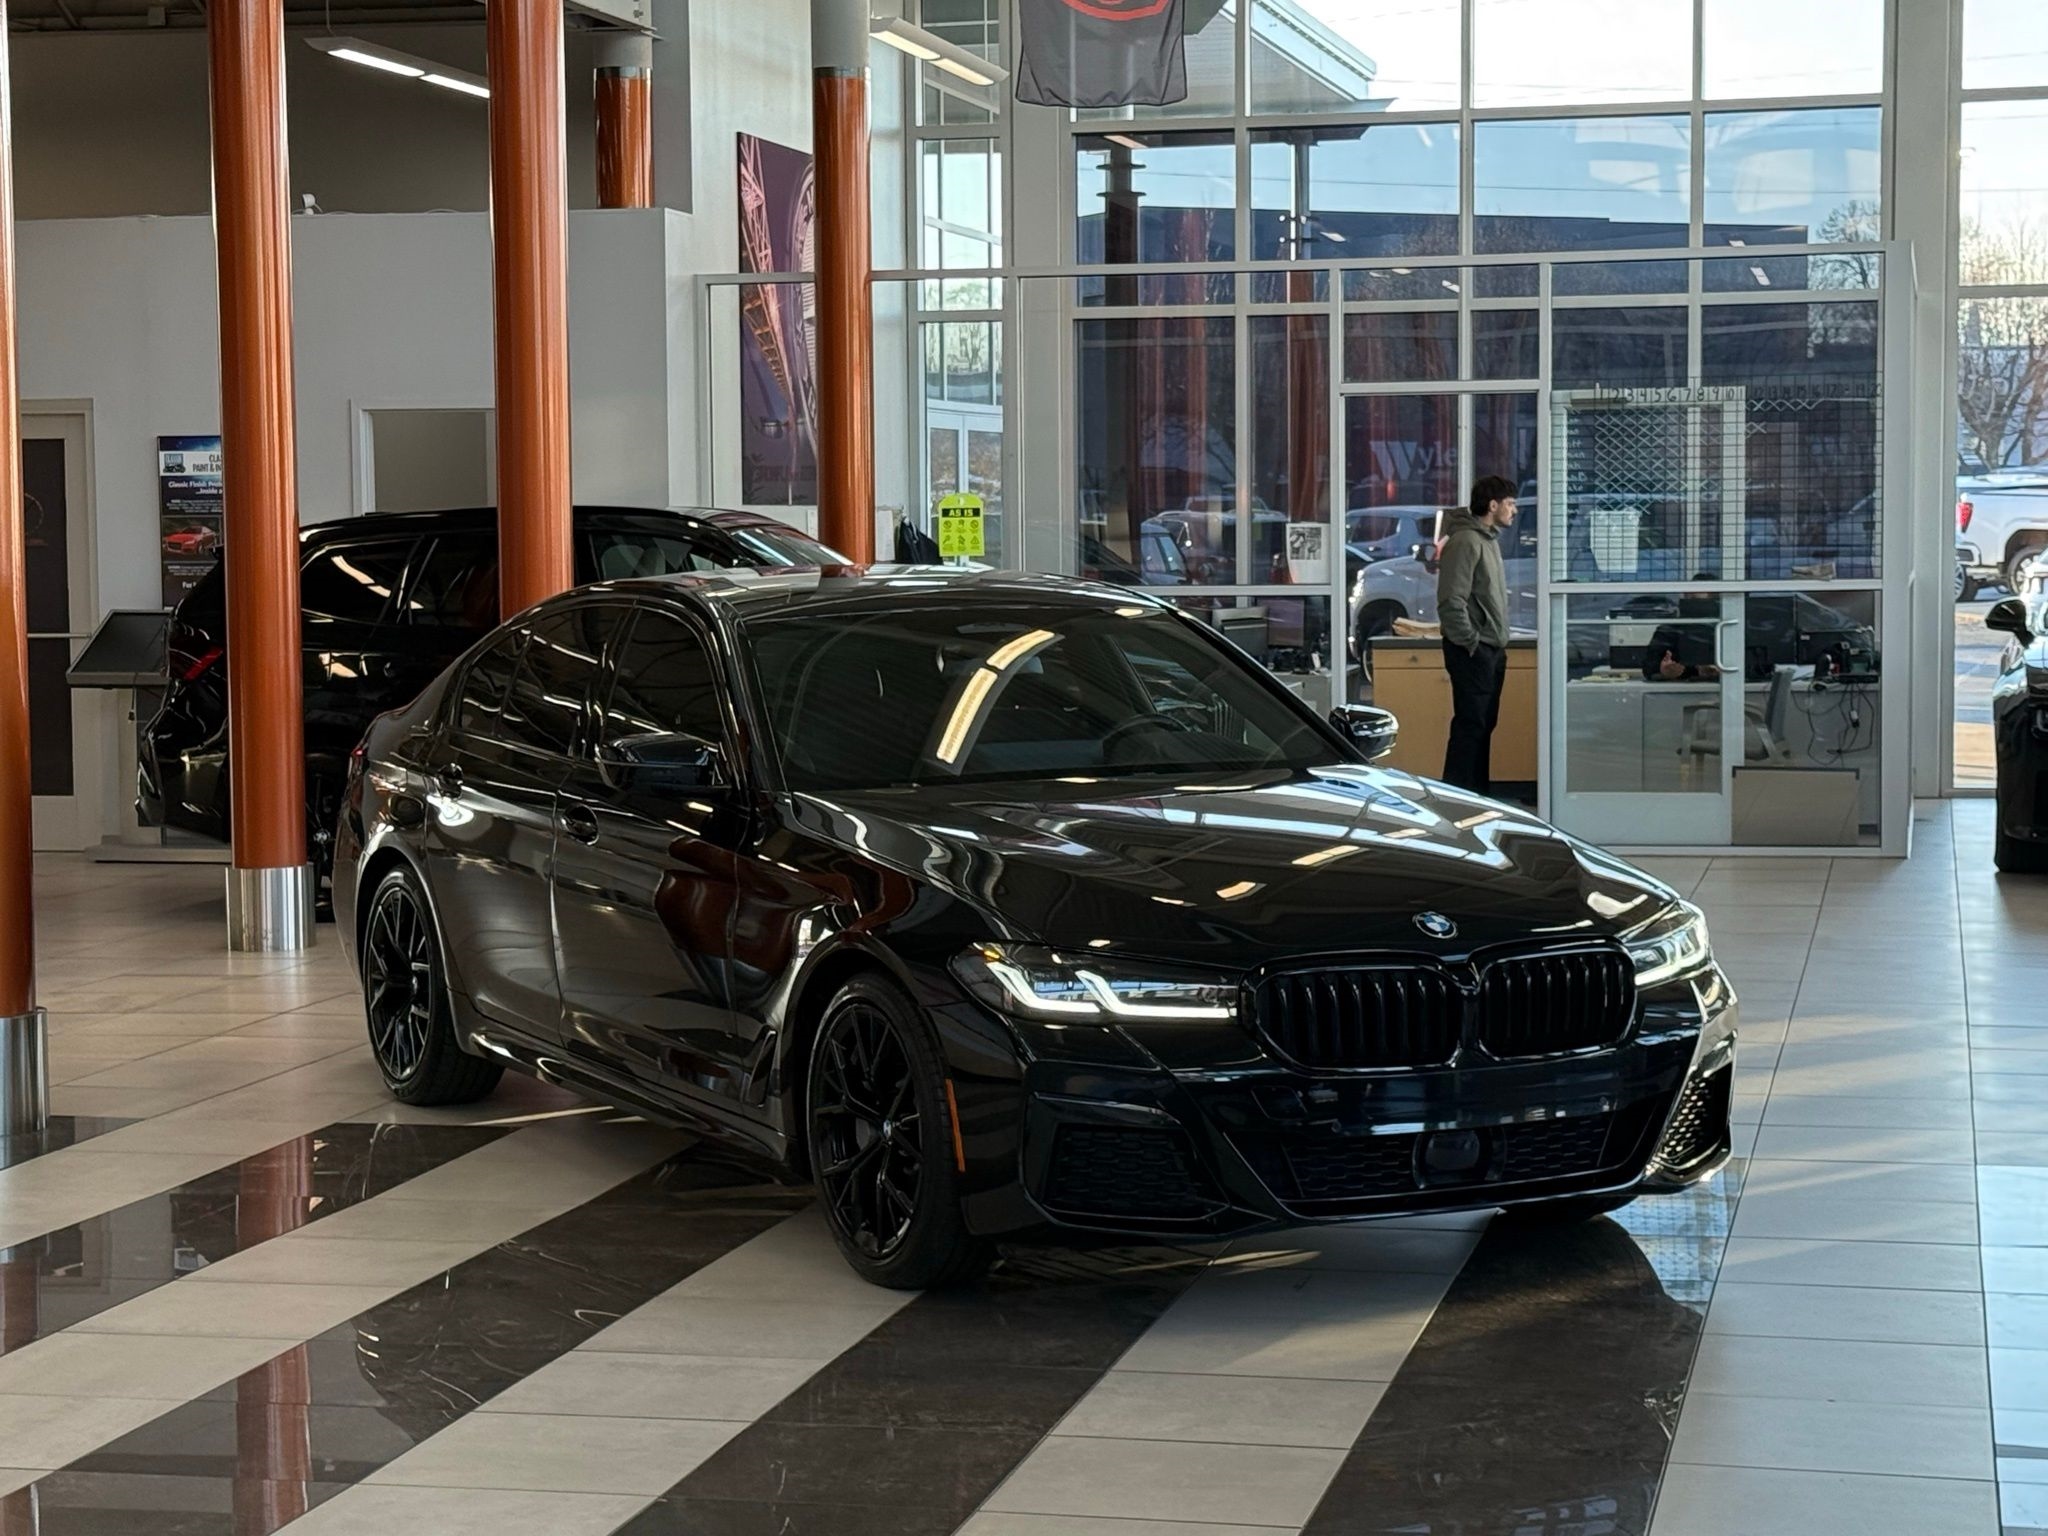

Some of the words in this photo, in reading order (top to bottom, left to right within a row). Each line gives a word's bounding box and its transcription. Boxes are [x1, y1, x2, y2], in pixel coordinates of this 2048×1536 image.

[1625, 387, 1634, 402] 3
[1640, 388, 1647, 401] 4
[1655, 387, 1662, 402] 5
[1667, 387, 1677, 402] 6
[1683, 388, 1691, 401] 7
[1697, 386, 1704, 402] 8
[1712, 387, 1719, 400] 9
[1725, 388, 1735, 400] 10
[949, 508, 961, 517] AS
[964, 508, 973, 517] IS
